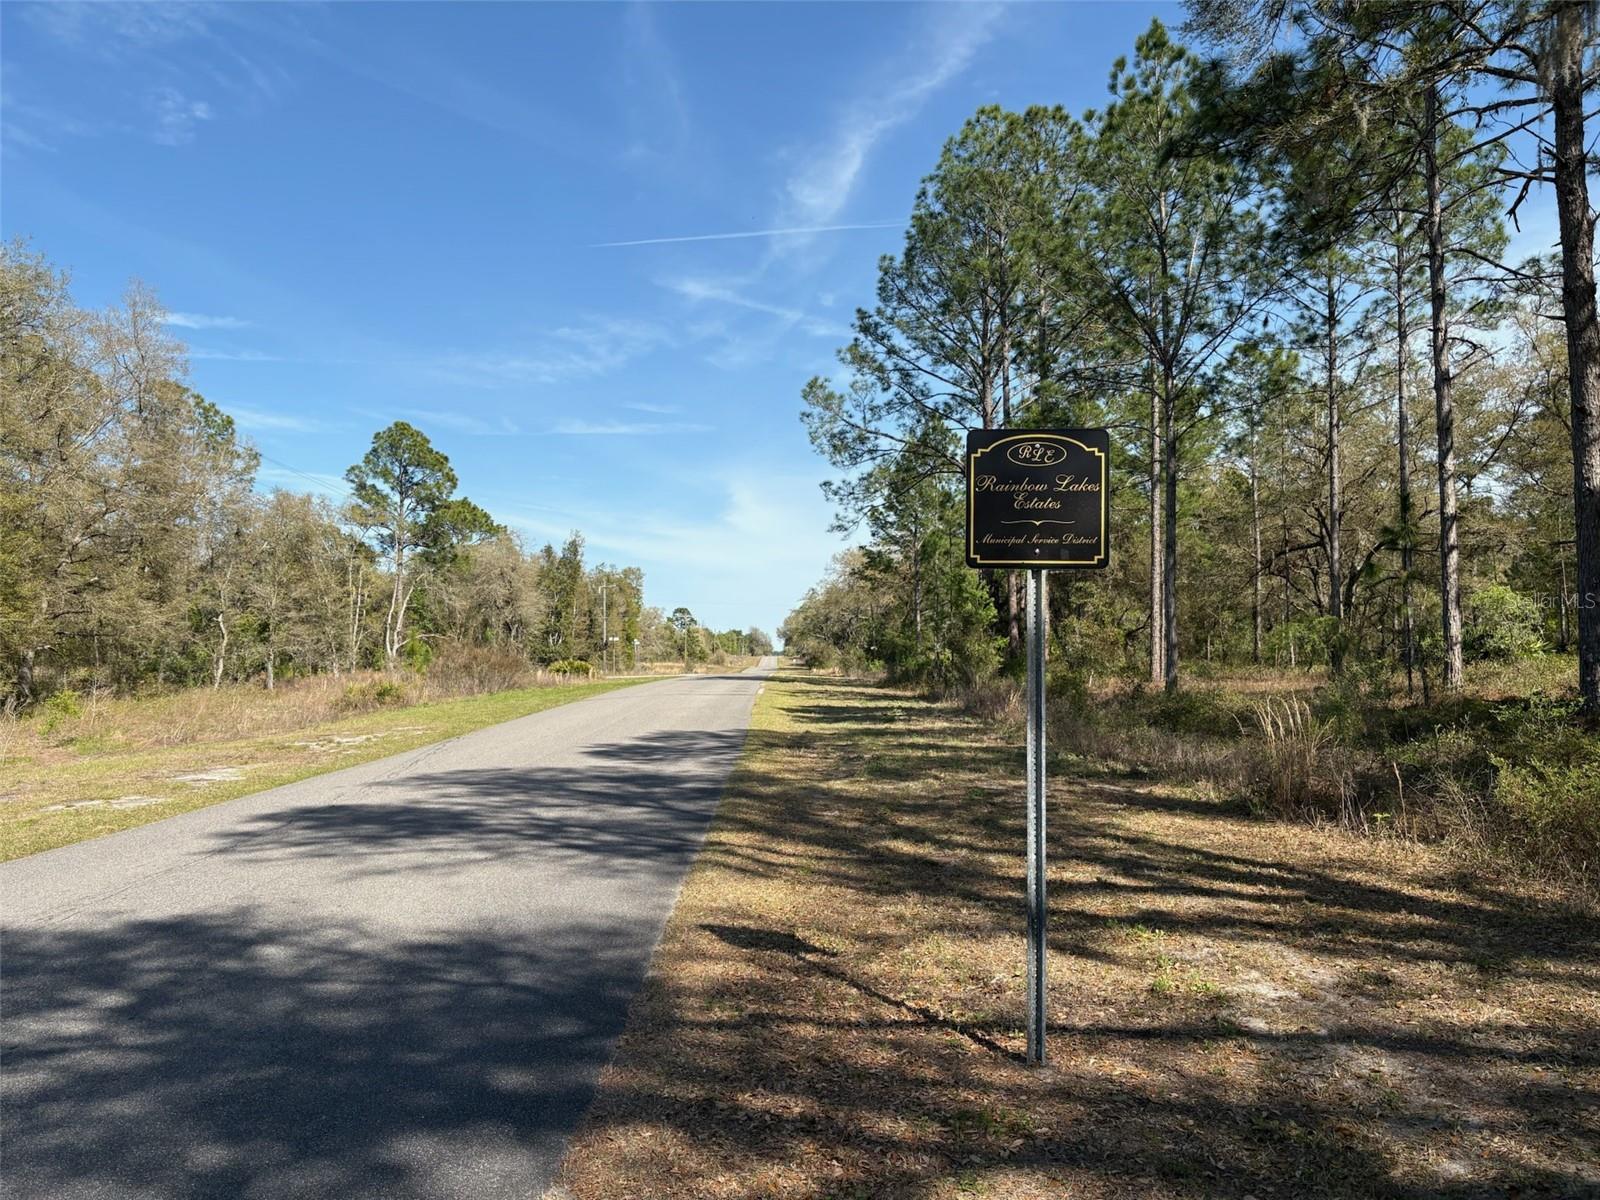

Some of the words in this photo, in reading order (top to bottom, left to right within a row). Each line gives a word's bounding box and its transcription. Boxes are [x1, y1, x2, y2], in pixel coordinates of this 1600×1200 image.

[975, 474, 1049, 492] Rainbow
[1053, 473, 1100, 492] Lakes
[1013, 492, 1062, 510] Estates
[976, 533, 1027, 547] Municipal
[1027, 533, 1059, 544] Service
[1062, 533, 1098, 544] District
